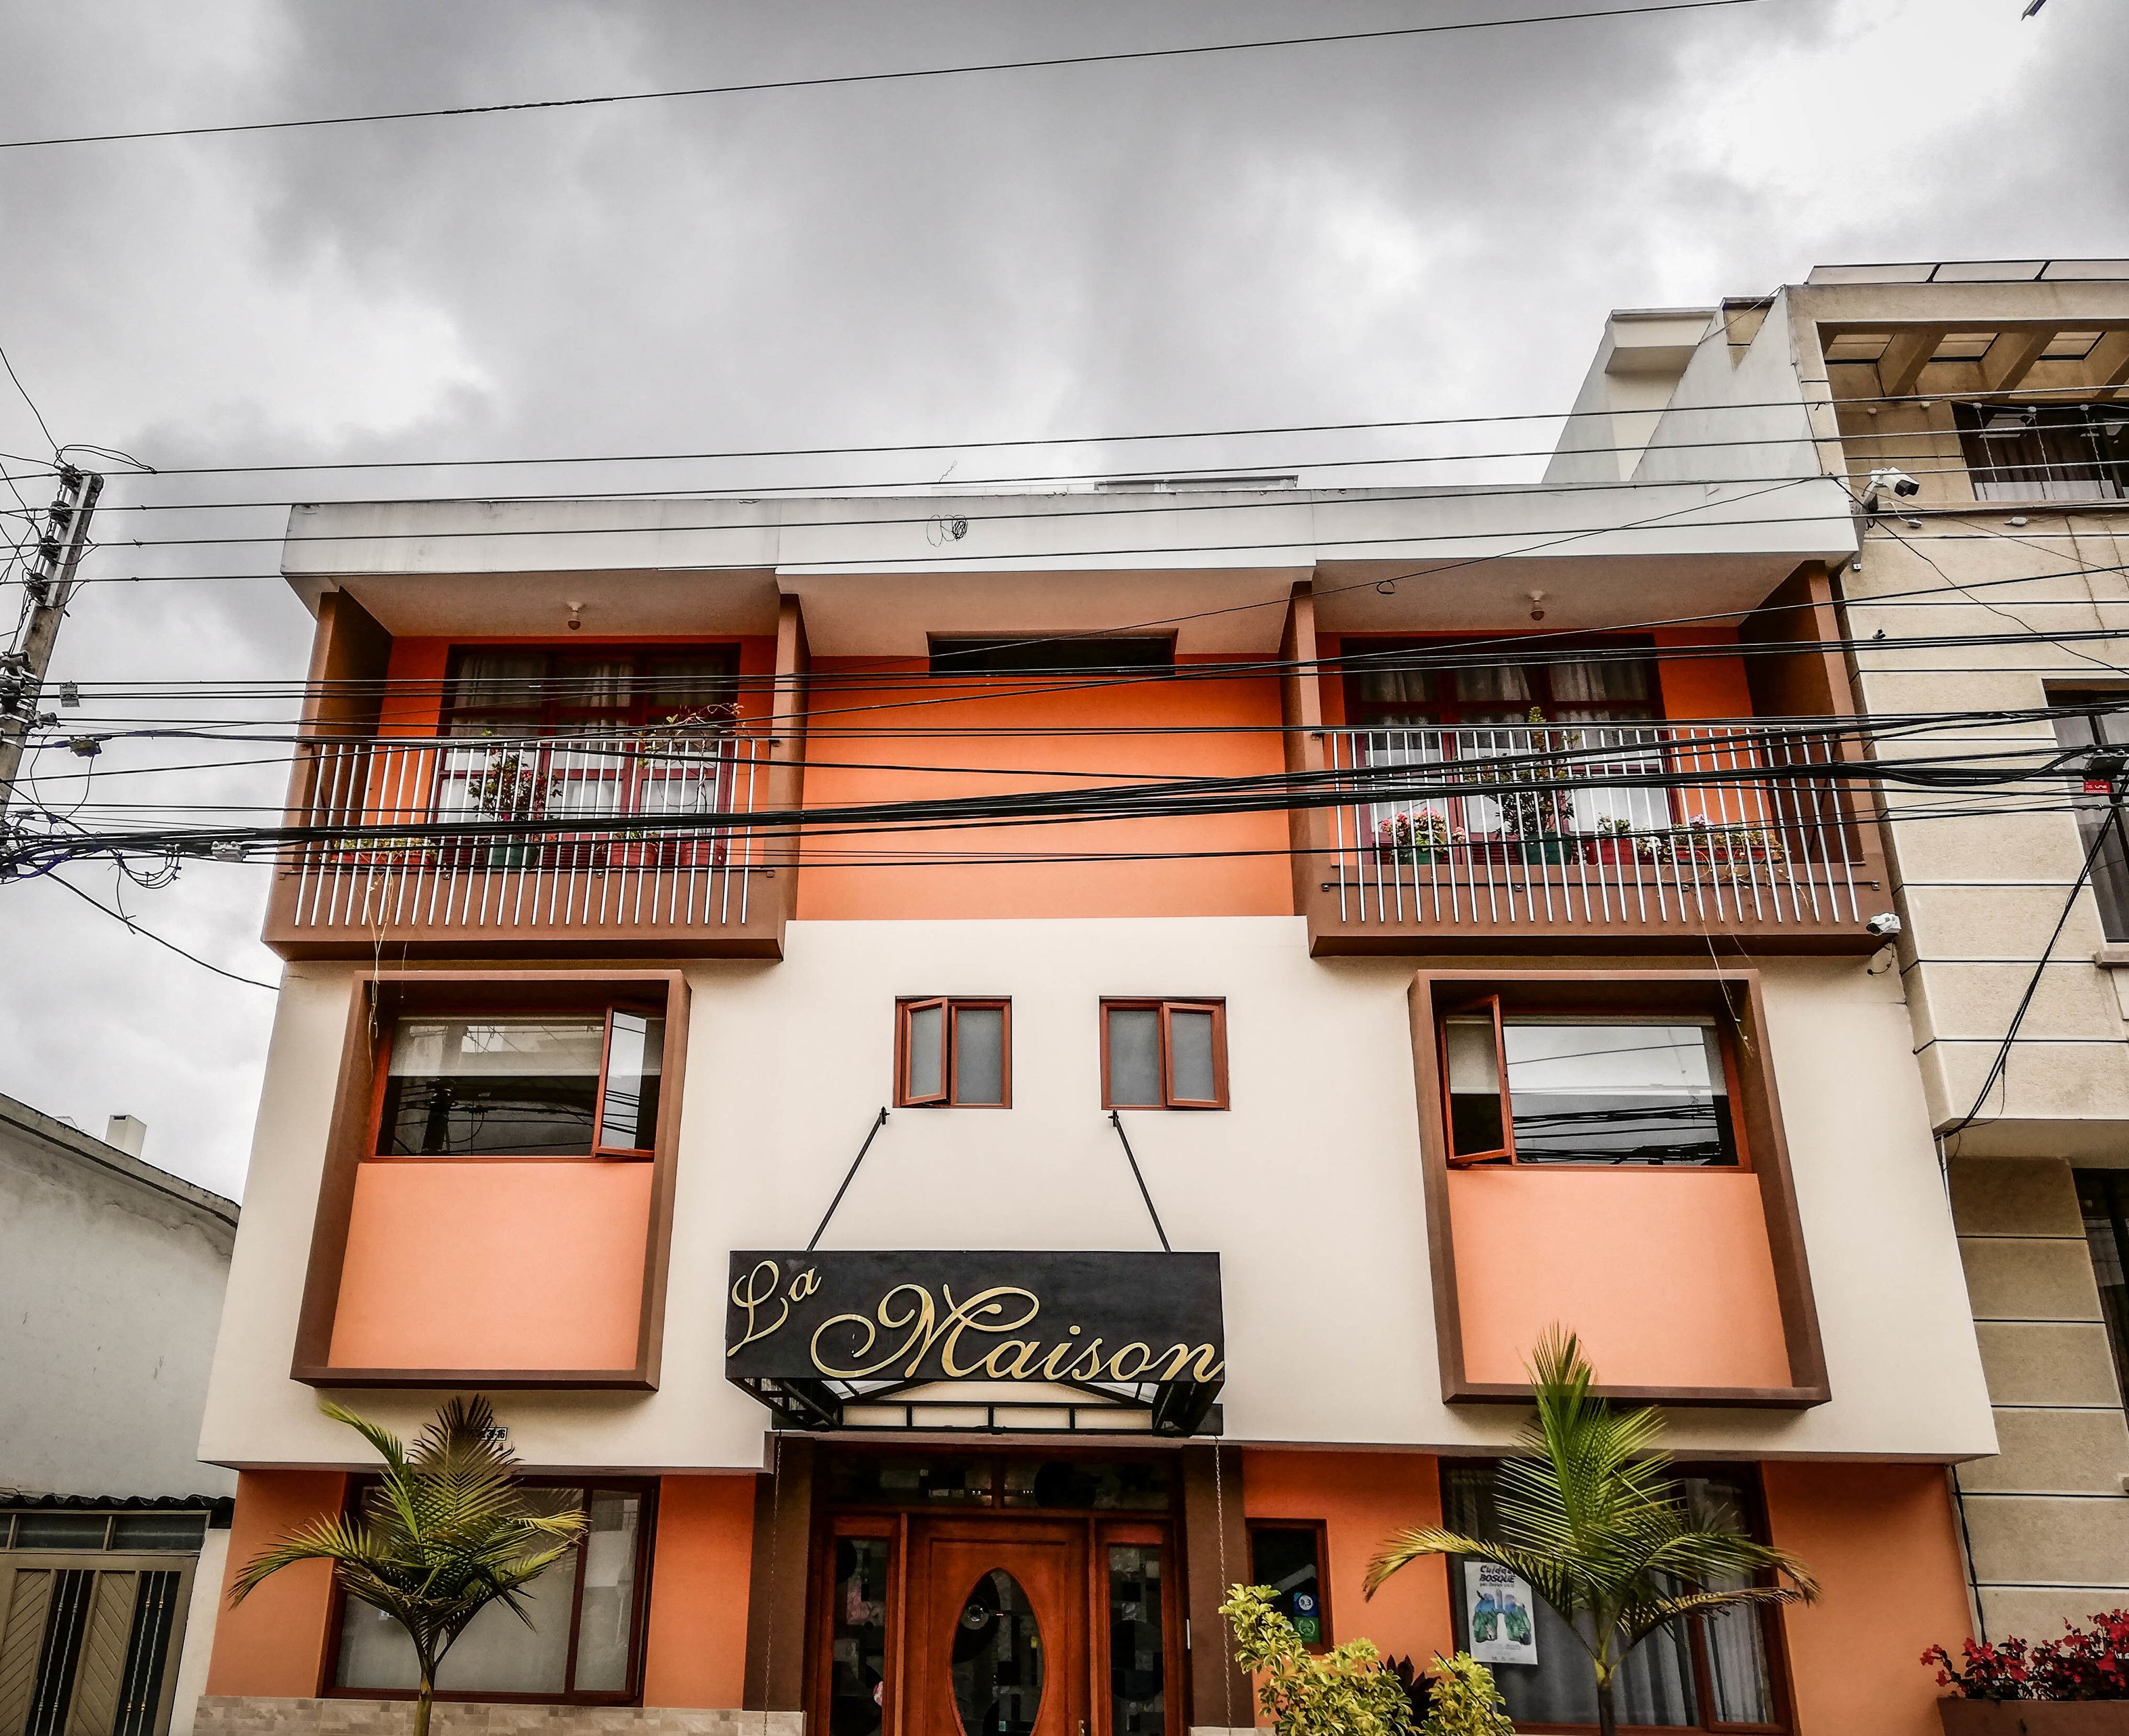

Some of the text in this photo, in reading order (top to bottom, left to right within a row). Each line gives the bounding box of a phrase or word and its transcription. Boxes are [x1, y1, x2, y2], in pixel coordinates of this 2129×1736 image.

[726, 1260, 822, 1357] La
[811, 1284, 1225, 1382] Maison
[1480, 1574, 1516, 1583] BOSQUE
